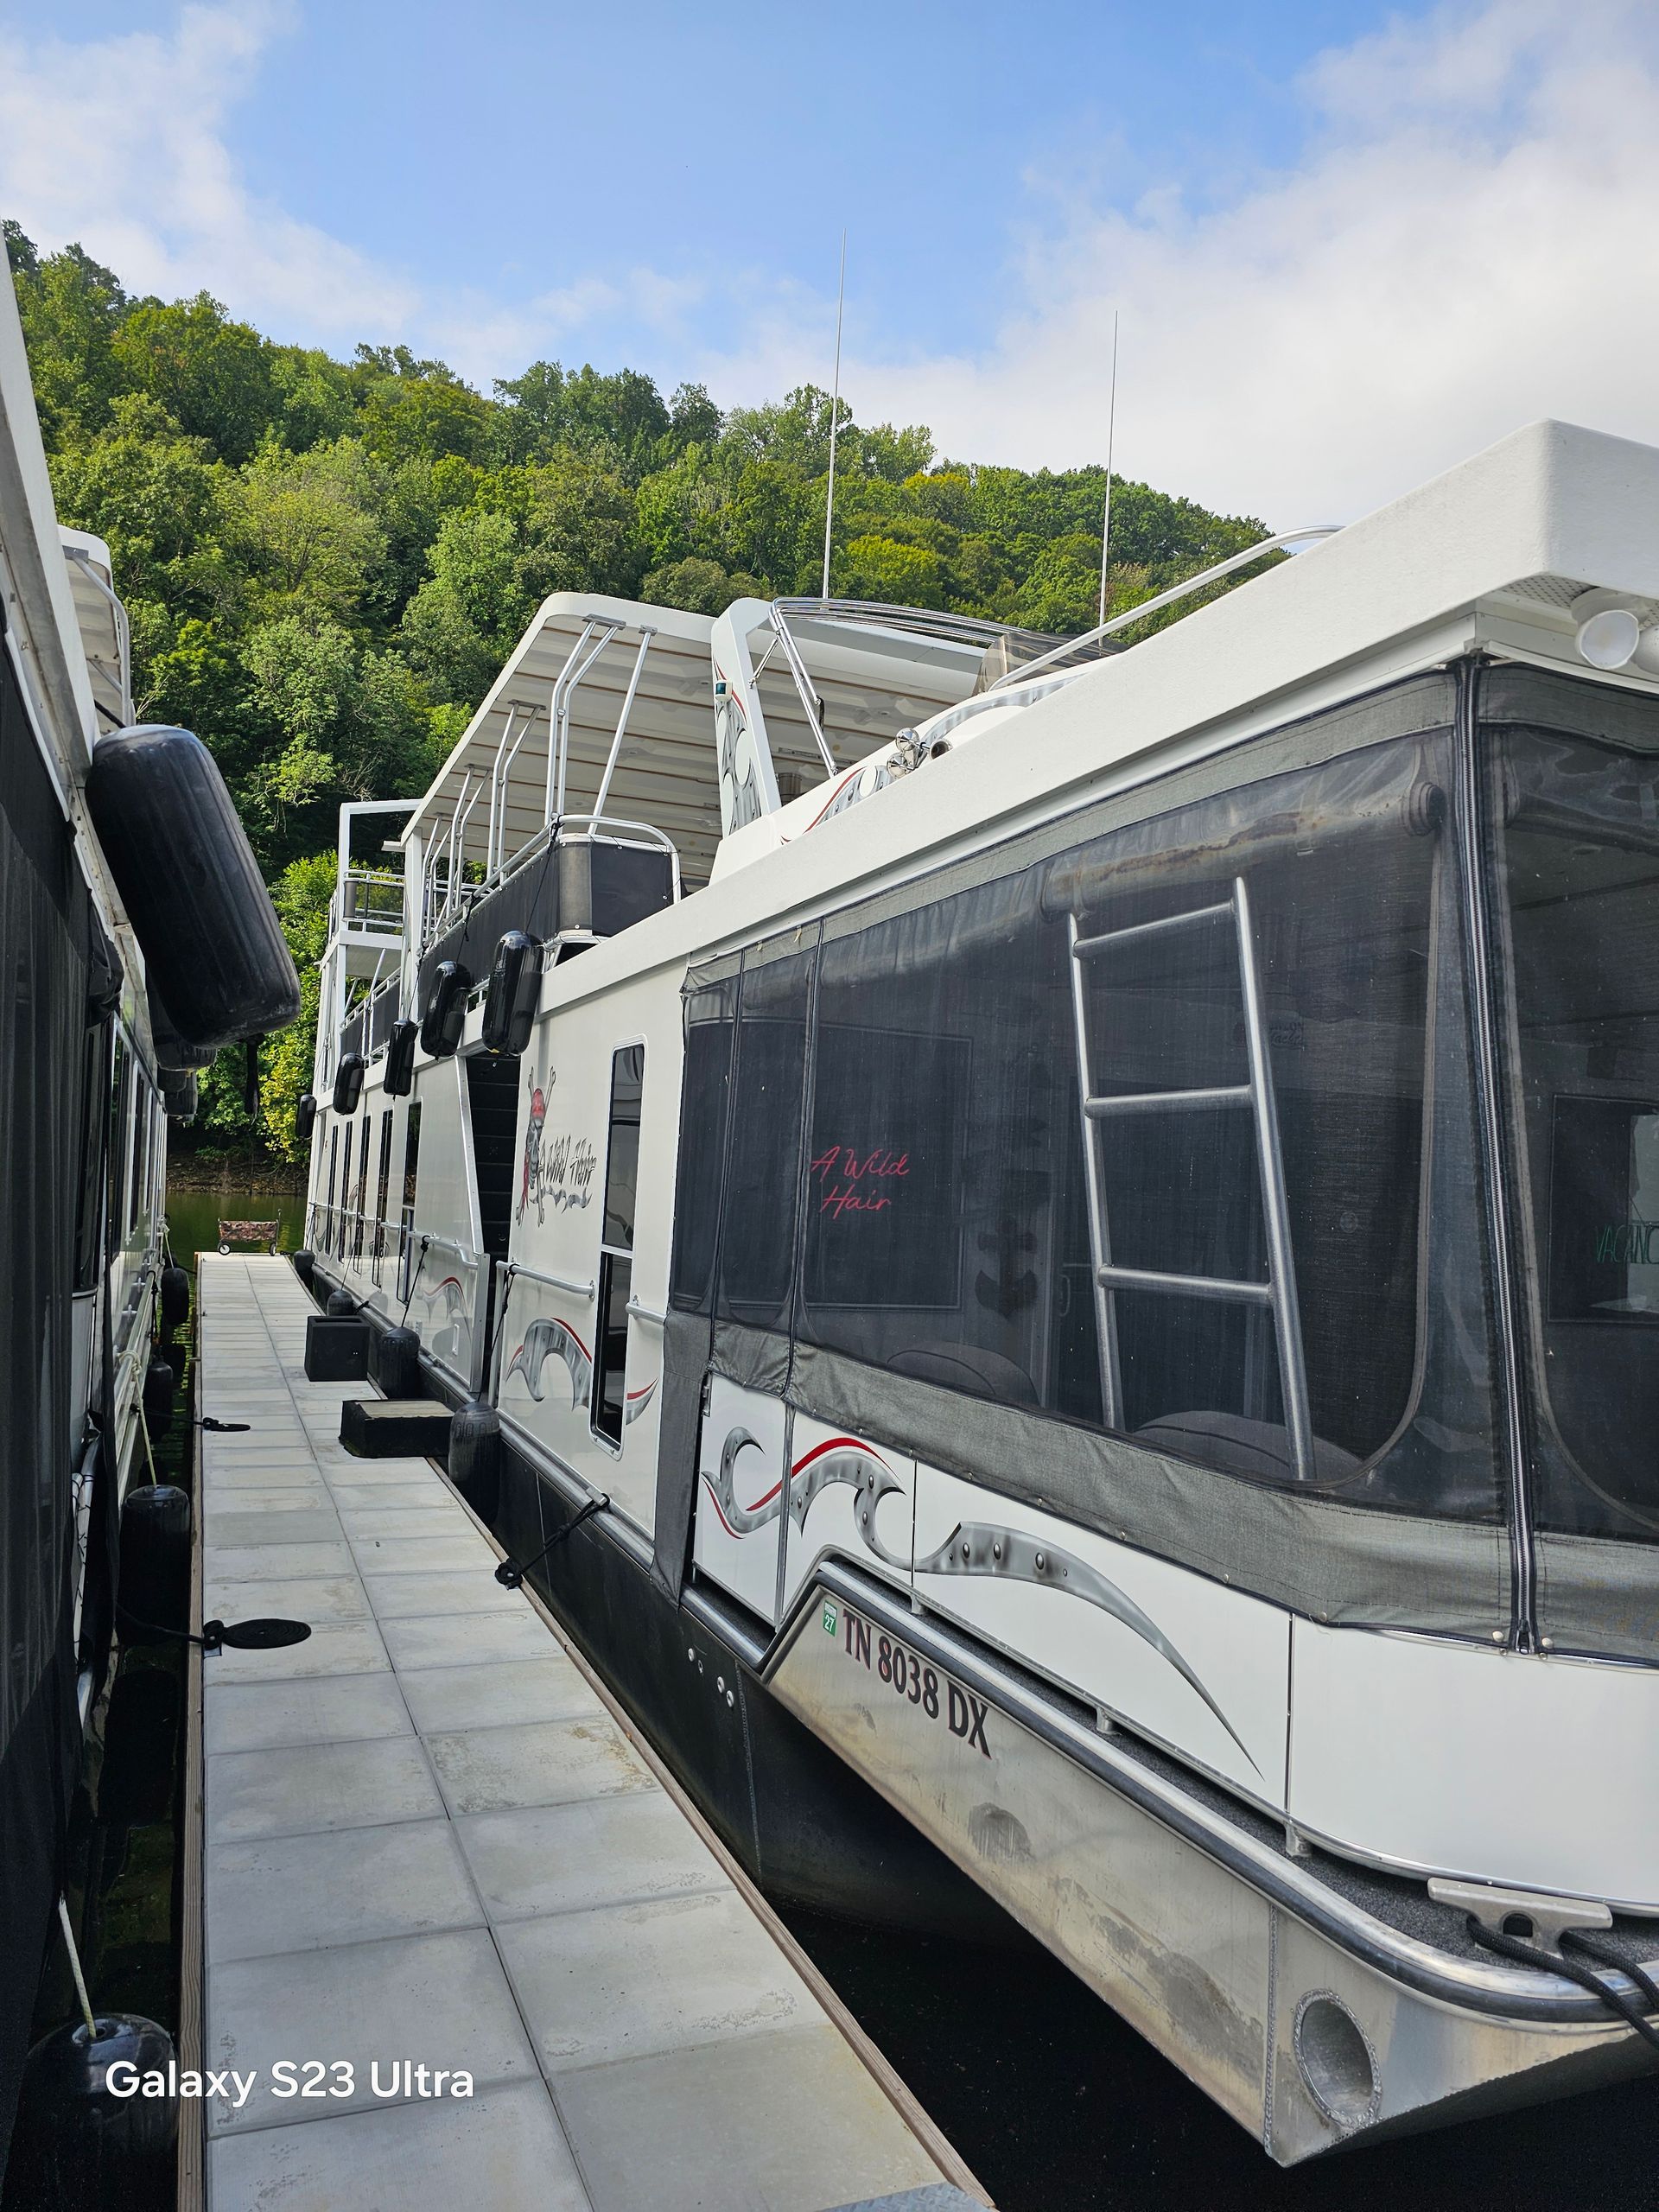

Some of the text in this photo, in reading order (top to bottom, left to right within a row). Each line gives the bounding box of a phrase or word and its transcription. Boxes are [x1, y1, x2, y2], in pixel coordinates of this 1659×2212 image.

[810, 1146, 910, 1183] A Wild
[819, 1184, 892, 1219] Hair
[824, 1613, 836, 1632] 27
[842, 1608, 992, 1760] TN 8038 DX
